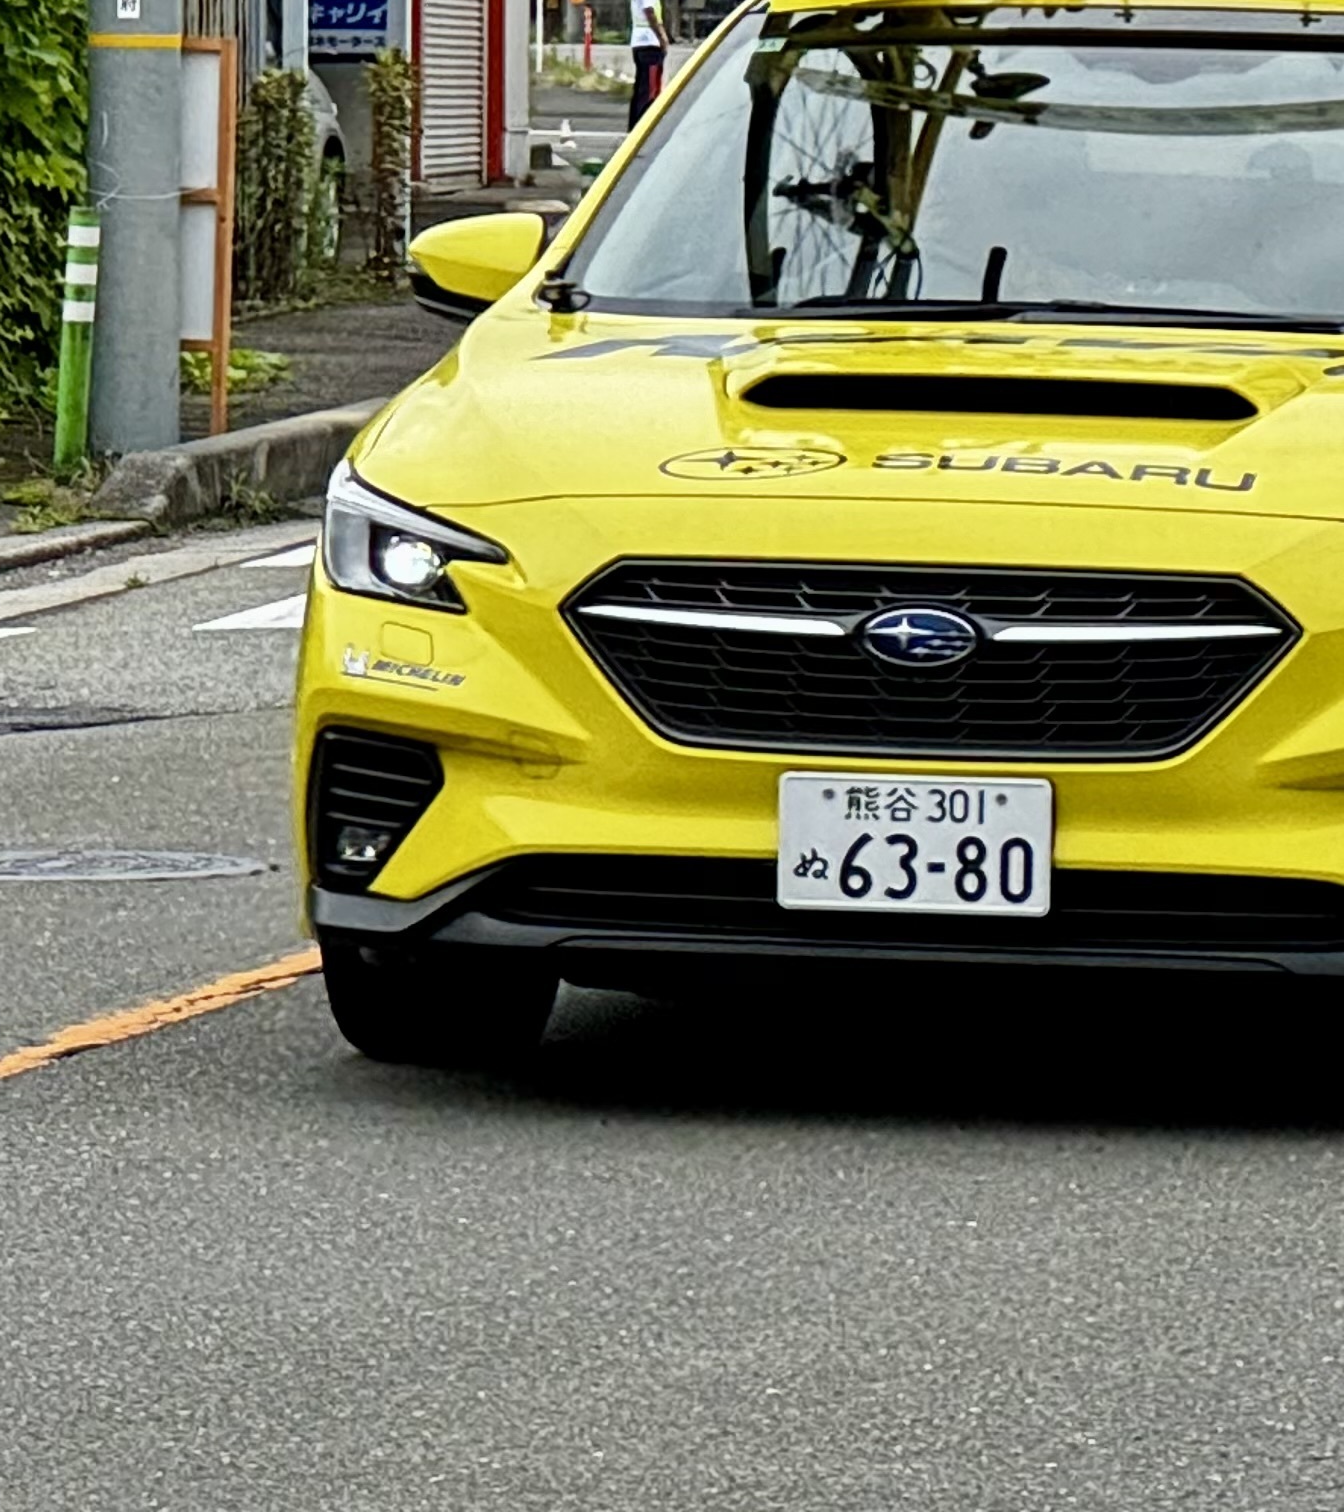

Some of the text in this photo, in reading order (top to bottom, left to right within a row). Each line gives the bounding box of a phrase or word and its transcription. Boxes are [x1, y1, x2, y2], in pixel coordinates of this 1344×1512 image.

[874, 452, 1257, 491] SUBARU
[844, 786, 985, 824] 熊谷 301
[793, 832, 1033, 903] ぬ 63-80
